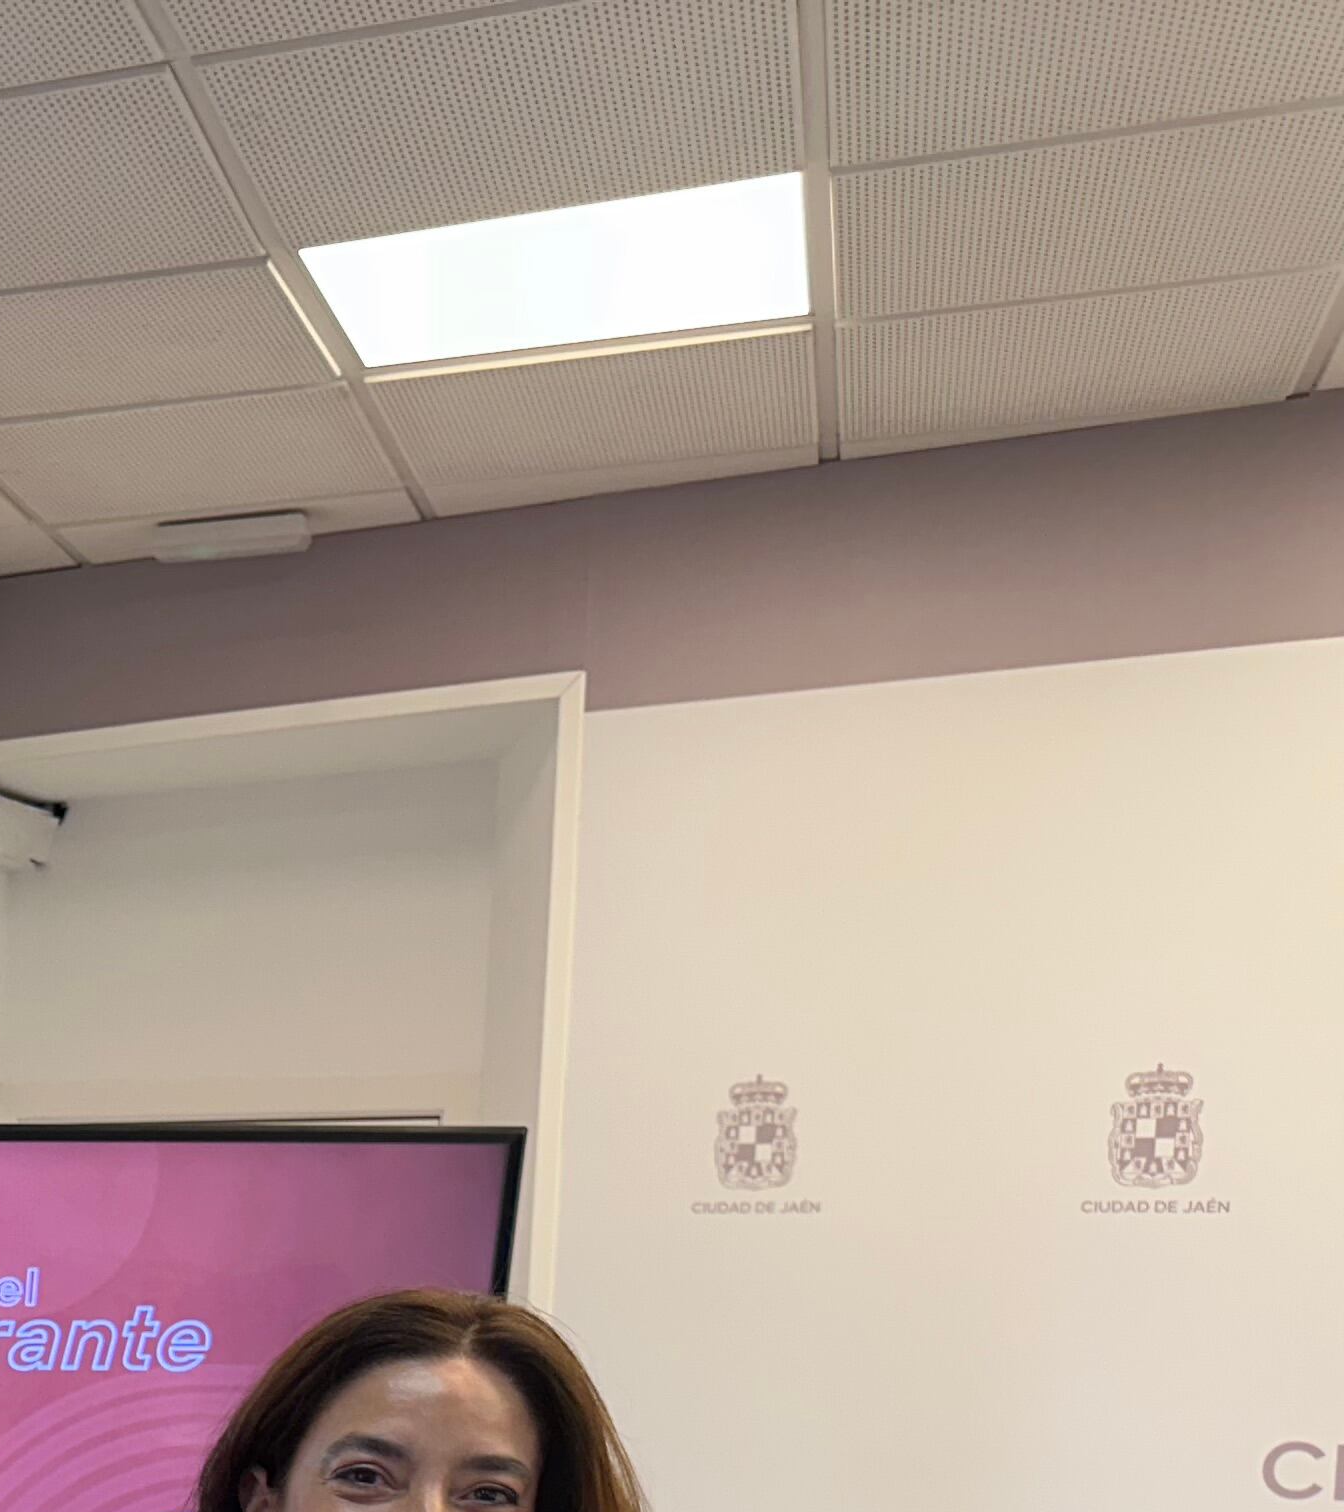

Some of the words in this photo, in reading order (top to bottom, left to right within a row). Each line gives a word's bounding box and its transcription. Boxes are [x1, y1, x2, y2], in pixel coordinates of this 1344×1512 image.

[754, 1201, 775, 1215] DE
[1080, 1200, 1151, 1214] CIUDAD
[1153, 1200, 1178, 1214] DE
[1182, 1196, 1231, 1213] JAÉN
